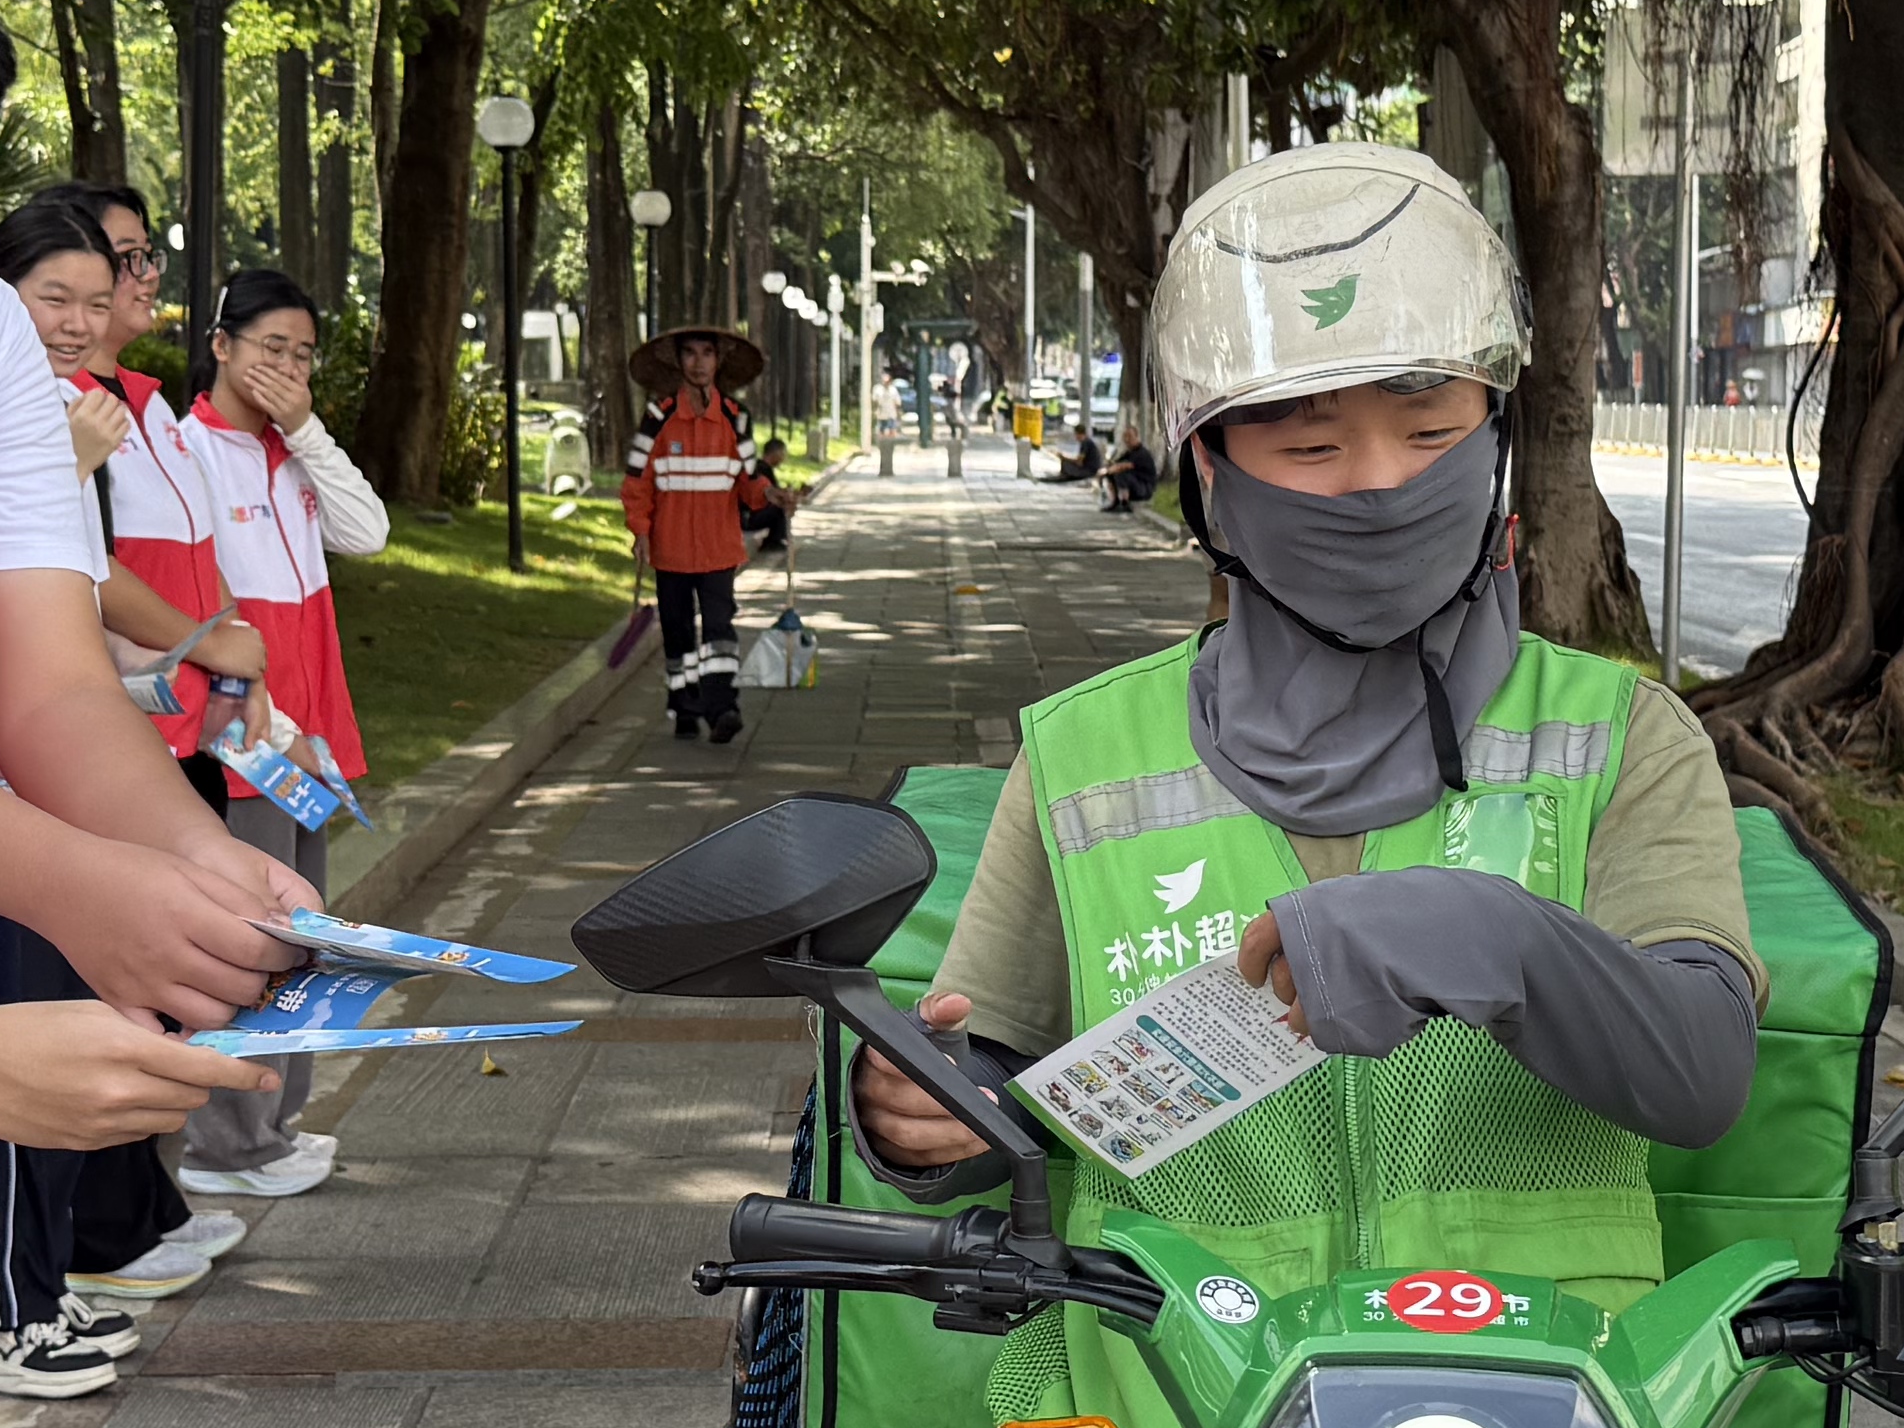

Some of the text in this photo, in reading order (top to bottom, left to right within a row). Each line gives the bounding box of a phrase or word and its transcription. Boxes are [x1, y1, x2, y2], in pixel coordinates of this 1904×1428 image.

[1103, 909, 1260, 983] 朴朴超
[1403, 1281, 1492, 1318] 29
